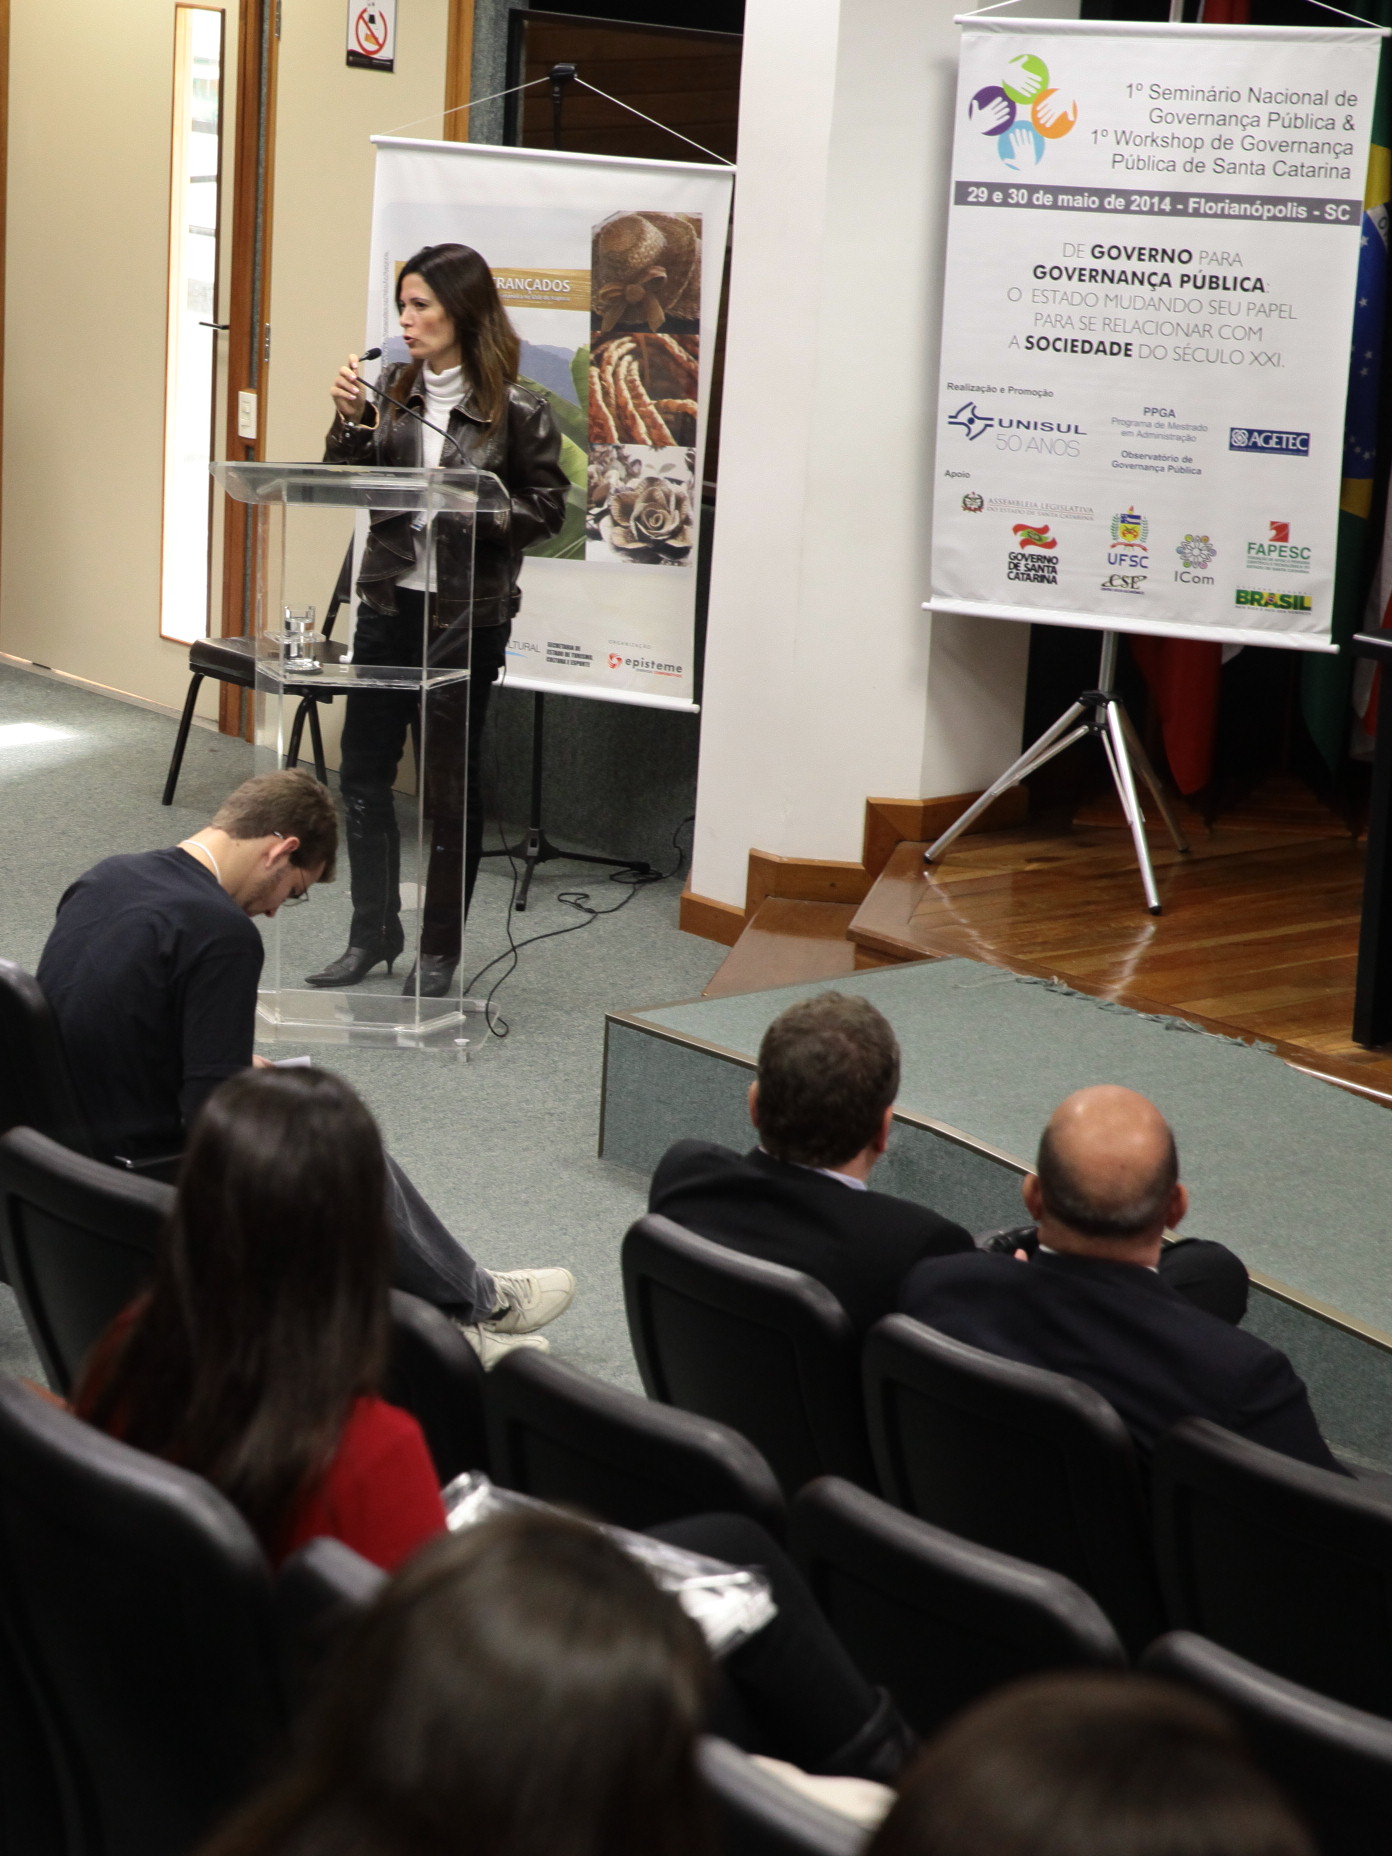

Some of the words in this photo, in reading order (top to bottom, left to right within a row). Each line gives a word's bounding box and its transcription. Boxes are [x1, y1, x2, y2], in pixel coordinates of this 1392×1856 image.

[1149, 84, 1241, 103] Seminário
[1248, 87, 1329, 106] Nacional
[1335, 91, 1358, 107] de
[1149, 108, 1261, 131] Governança
[1268, 111, 1336, 130] Pública
[1342, 115, 1356, 131] &
[1114, 130, 1205, 153] Workshop
[1211, 134, 1234, 151] de
[1241, 135, 1354, 159] Governança
[1112, 153, 1176, 173] Pública
[1183, 157, 1206, 173] de
[1212, 158, 1266, 176] Santa
[1273, 160, 1352, 180] Catarina
[967, 187, 988, 203] 29
[992, 191, 1003, 203] e
[1008, 189, 1028, 204] 30
[1032, 190, 1054, 206] de
[1057, 191, 1099, 208] maio
[1103, 193, 1125, 210] de
[1129, 194, 1171, 211] 2014
[1188, 198, 1308, 220] Florianópolis
[1324, 204, 1351, 221] SC
[1063, 243, 1085, 259] DE
[1091, 244, 1193, 264] GOVERNO
[1199, 250, 1243, 267] PARA
[1033, 264, 1172, 291] GOVERNANÇA
[1007, 288, 1022, 302] O
[1032, 289, 1099, 308] ESTADO
[1104, 293, 1203, 314] MUDANDO
[1208, 299, 1241, 316] SEU
[1247, 302, 1297, 320] PAPEL
[1034, 313, 1074, 329] PARA
[1078, 316, 1096, 331] SE
[1103, 318, 1213, 339] RELACIONAR
[1218, 325, 1263, 342] COM
[1008, 335, 1020, 349] A
[1025, 335, 1133, 357] SOCIEDADE
[1138, 344, 1168, 360] DO
[1173, 342, 1244, 365] SÉCULO
[947, 383, 997, 395] Realização
[1008, 386, 1054, 398] Promoção
[1143, 407, 1176, 418] PPGA
[998, 418, 1087, 435] UNISUL
[1111, 417, 1152, 429] Programa
[1154, 421, 1165, 429] de
[1167, 423, 1208, 432] Mestrado
[995, 434, 1022, 451] 50
[1025, 437, 1081, 457] ANOS
[1136, 431, 1197, 443] Administração
[1248, 432, 1308, 450] AGETEC
[1121, 450, 1180, 463] Observatório
[1182, 455, 1193, 464] de
[944, 470, 971, 479] Apoio
[1111, 460, 1165, 473] Governança
[1167, 464, 1202, 475] Pública
[988, 498, 1038, 510] ASSEMBLEIA
[1040, 502, 1094, 514] LEGISLATIVA
[1009, 551, 1059, 566] GOVERNO
[1247, 542, 1311, 559] FAPESC
[1008, 561, 1021, 571] DE
[1024, 563, 1058, 575] SANTA
[1108, 553, 1149, 569] UFSC
[1007, 571, 1058, 585] CATARINA
[1109, 574, 1141, 589] CSE
[1174, 571, 1214, 585] ICom
[1235, 589, 1312, 611] BRASIL
[507, 639, 541, 653] LTURAL
[625, 657, 683, 674] episteme
